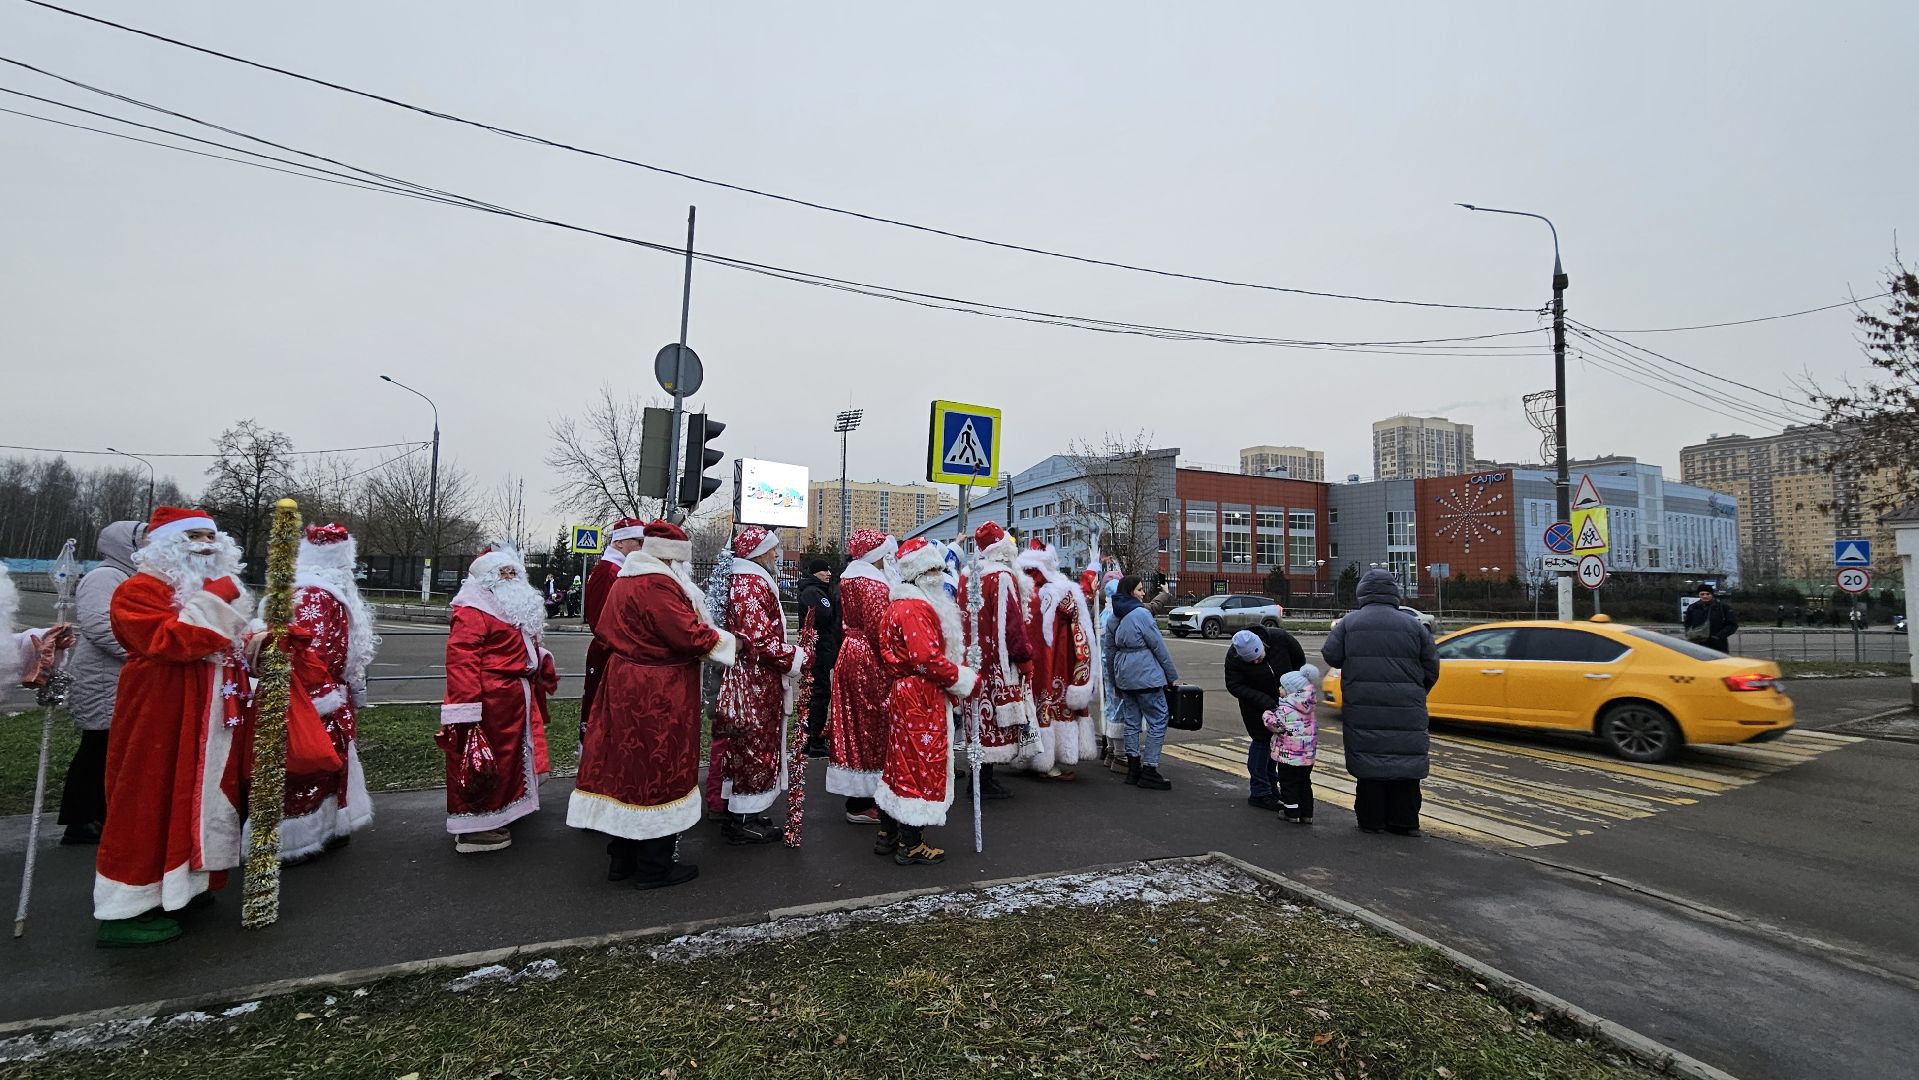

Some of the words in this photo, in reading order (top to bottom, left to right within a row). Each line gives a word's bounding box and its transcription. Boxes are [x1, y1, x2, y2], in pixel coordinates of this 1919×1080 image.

[1470, 472, 1506, 485] САЛЮТ
[1583, 564, 1601, 577] 40
[1843, 575, 1863, 586] 20
